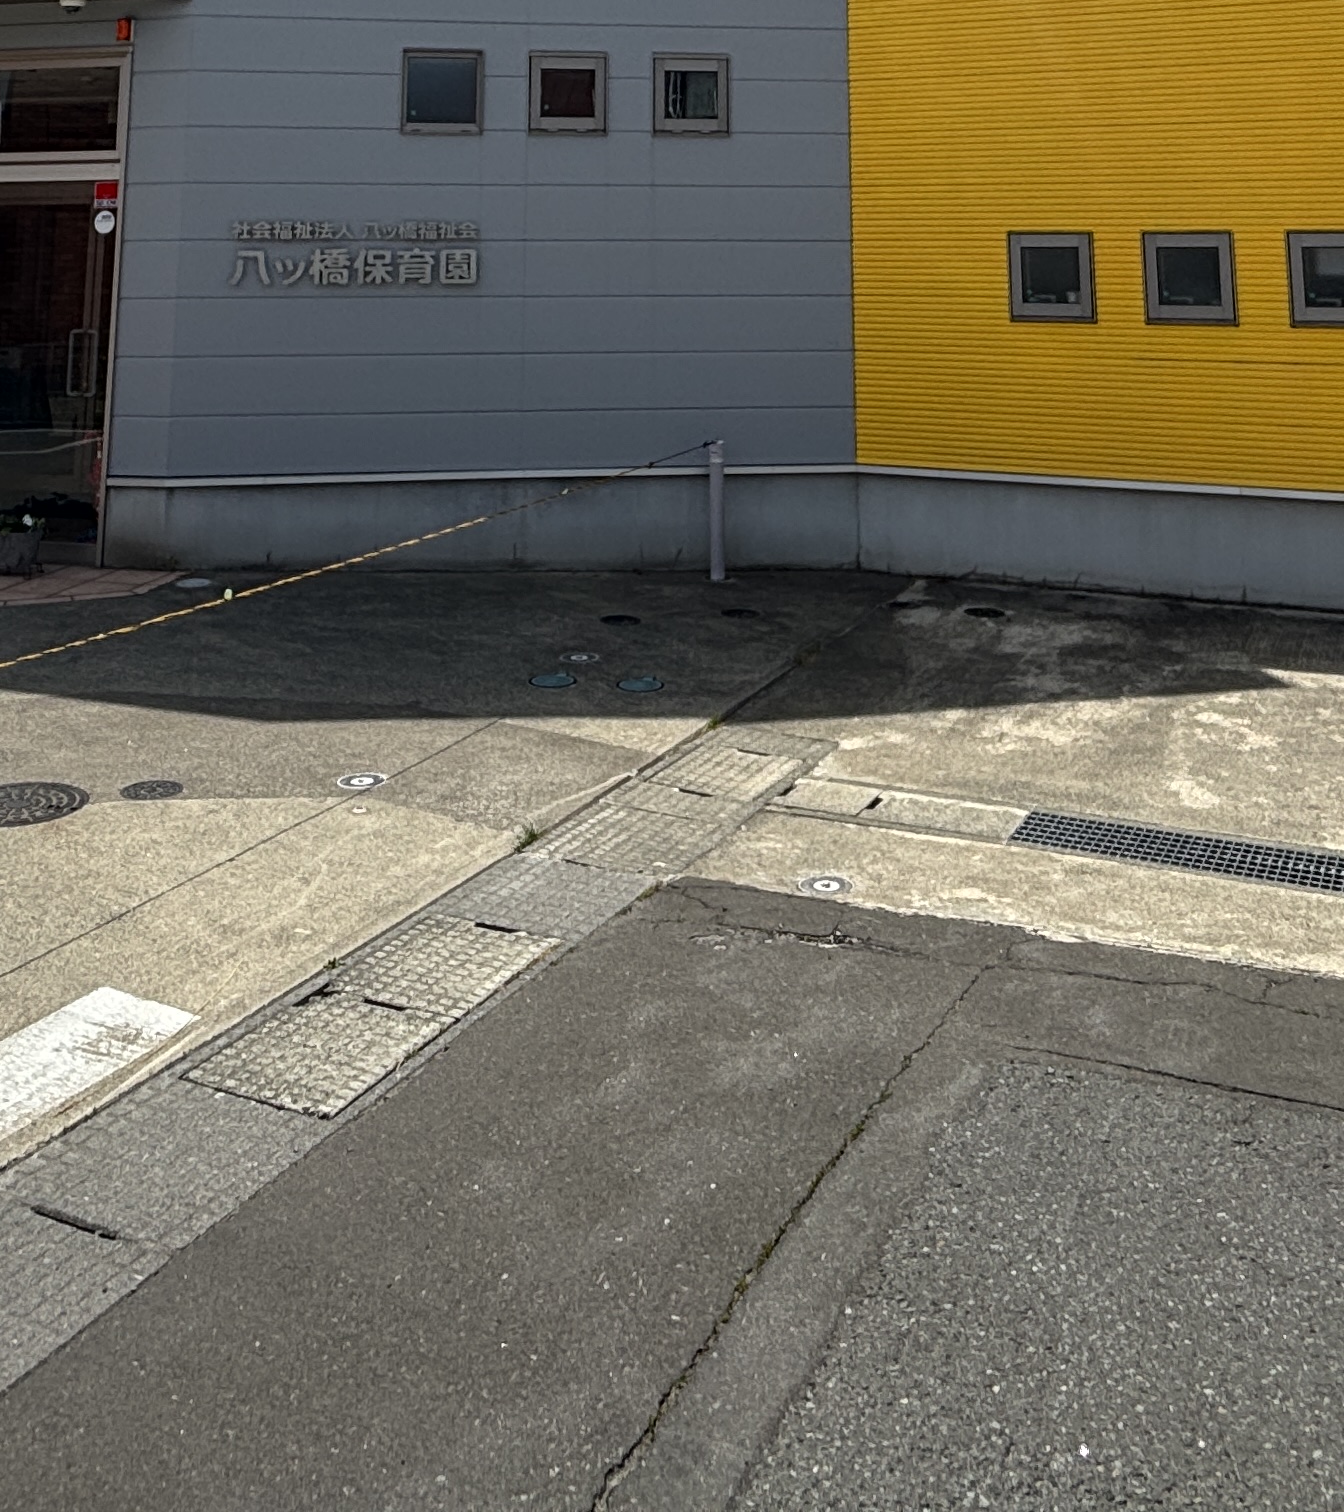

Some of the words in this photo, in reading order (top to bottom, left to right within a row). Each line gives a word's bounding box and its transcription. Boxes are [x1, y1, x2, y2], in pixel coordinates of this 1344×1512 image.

[232, 220, 353, 240] 社会福祉法人
